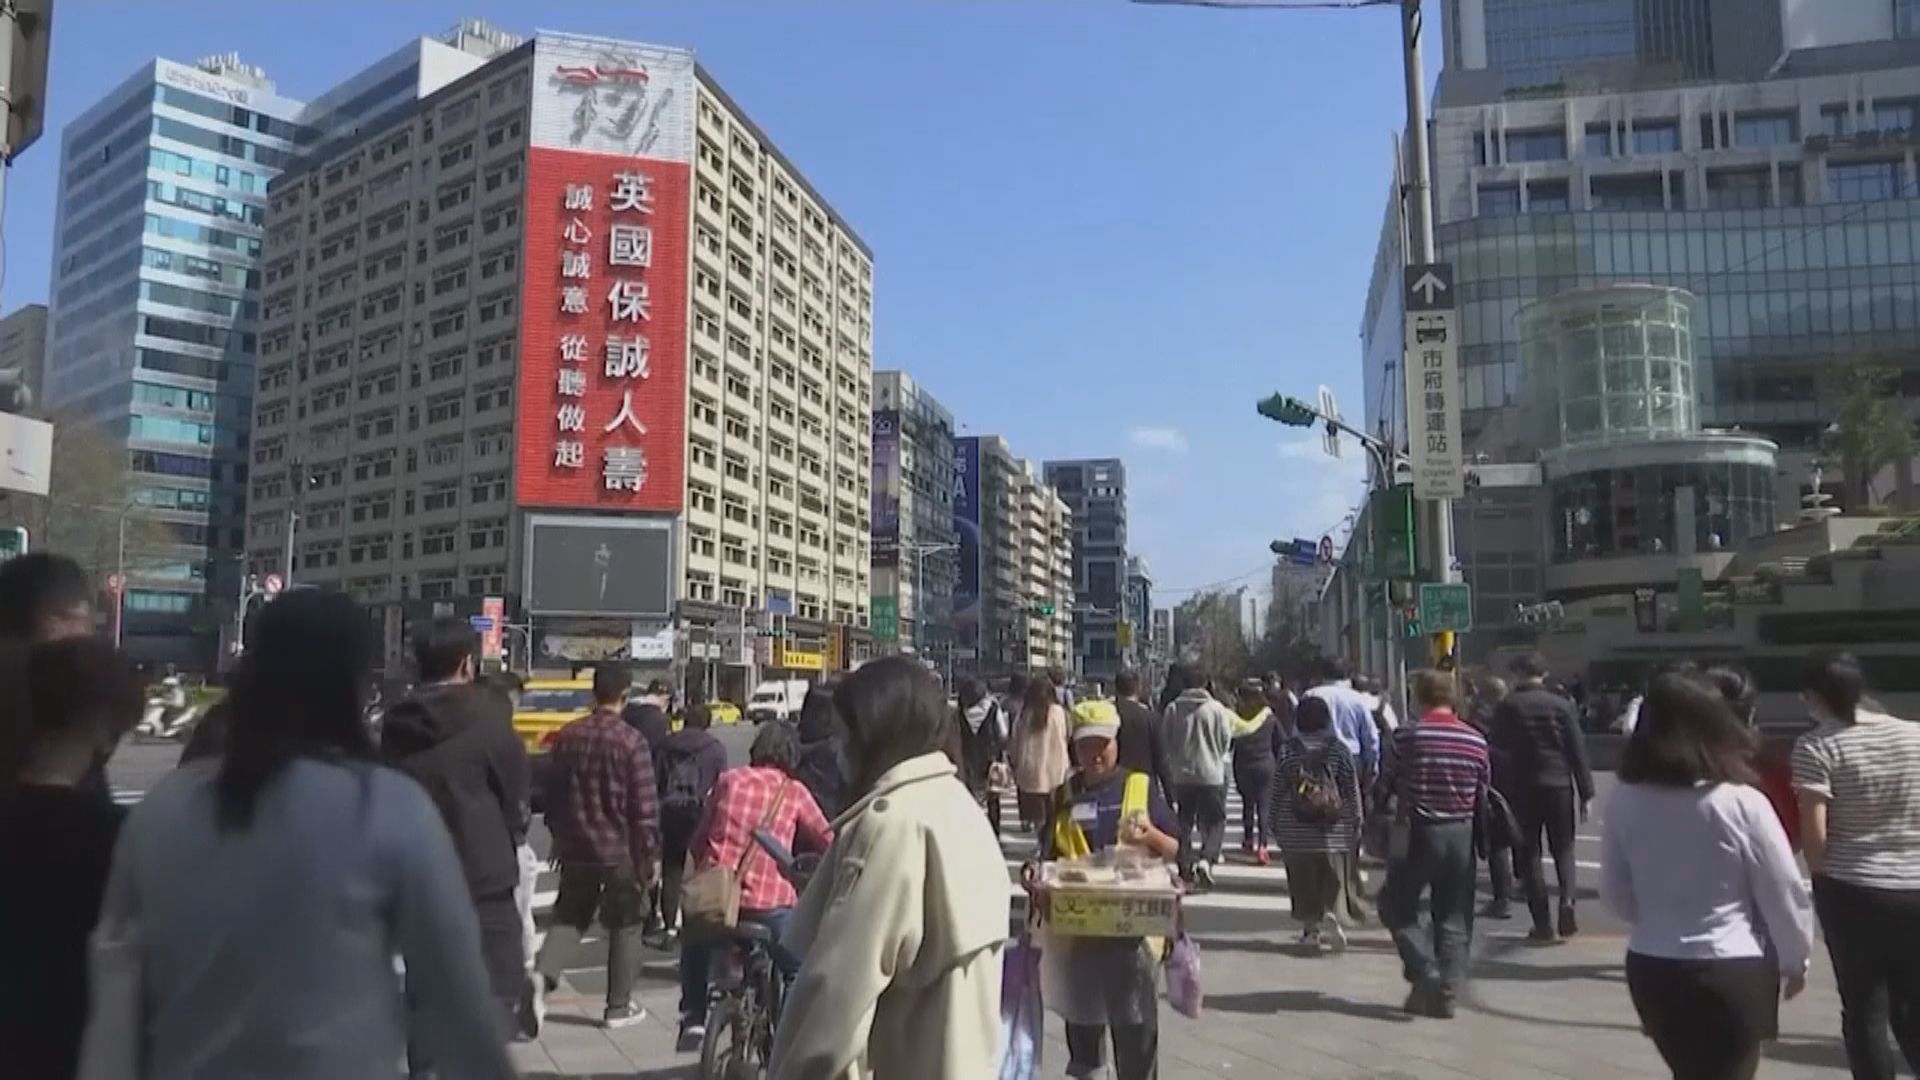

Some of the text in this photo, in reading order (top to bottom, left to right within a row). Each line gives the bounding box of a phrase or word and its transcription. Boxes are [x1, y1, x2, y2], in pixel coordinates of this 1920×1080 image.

[555, 184, 593, 468] 誠心誠意 從聽做起
[603, 170, 654, 492] 英國保誠人壽
[1422, 350, 1448, 453] 市府轉運站
